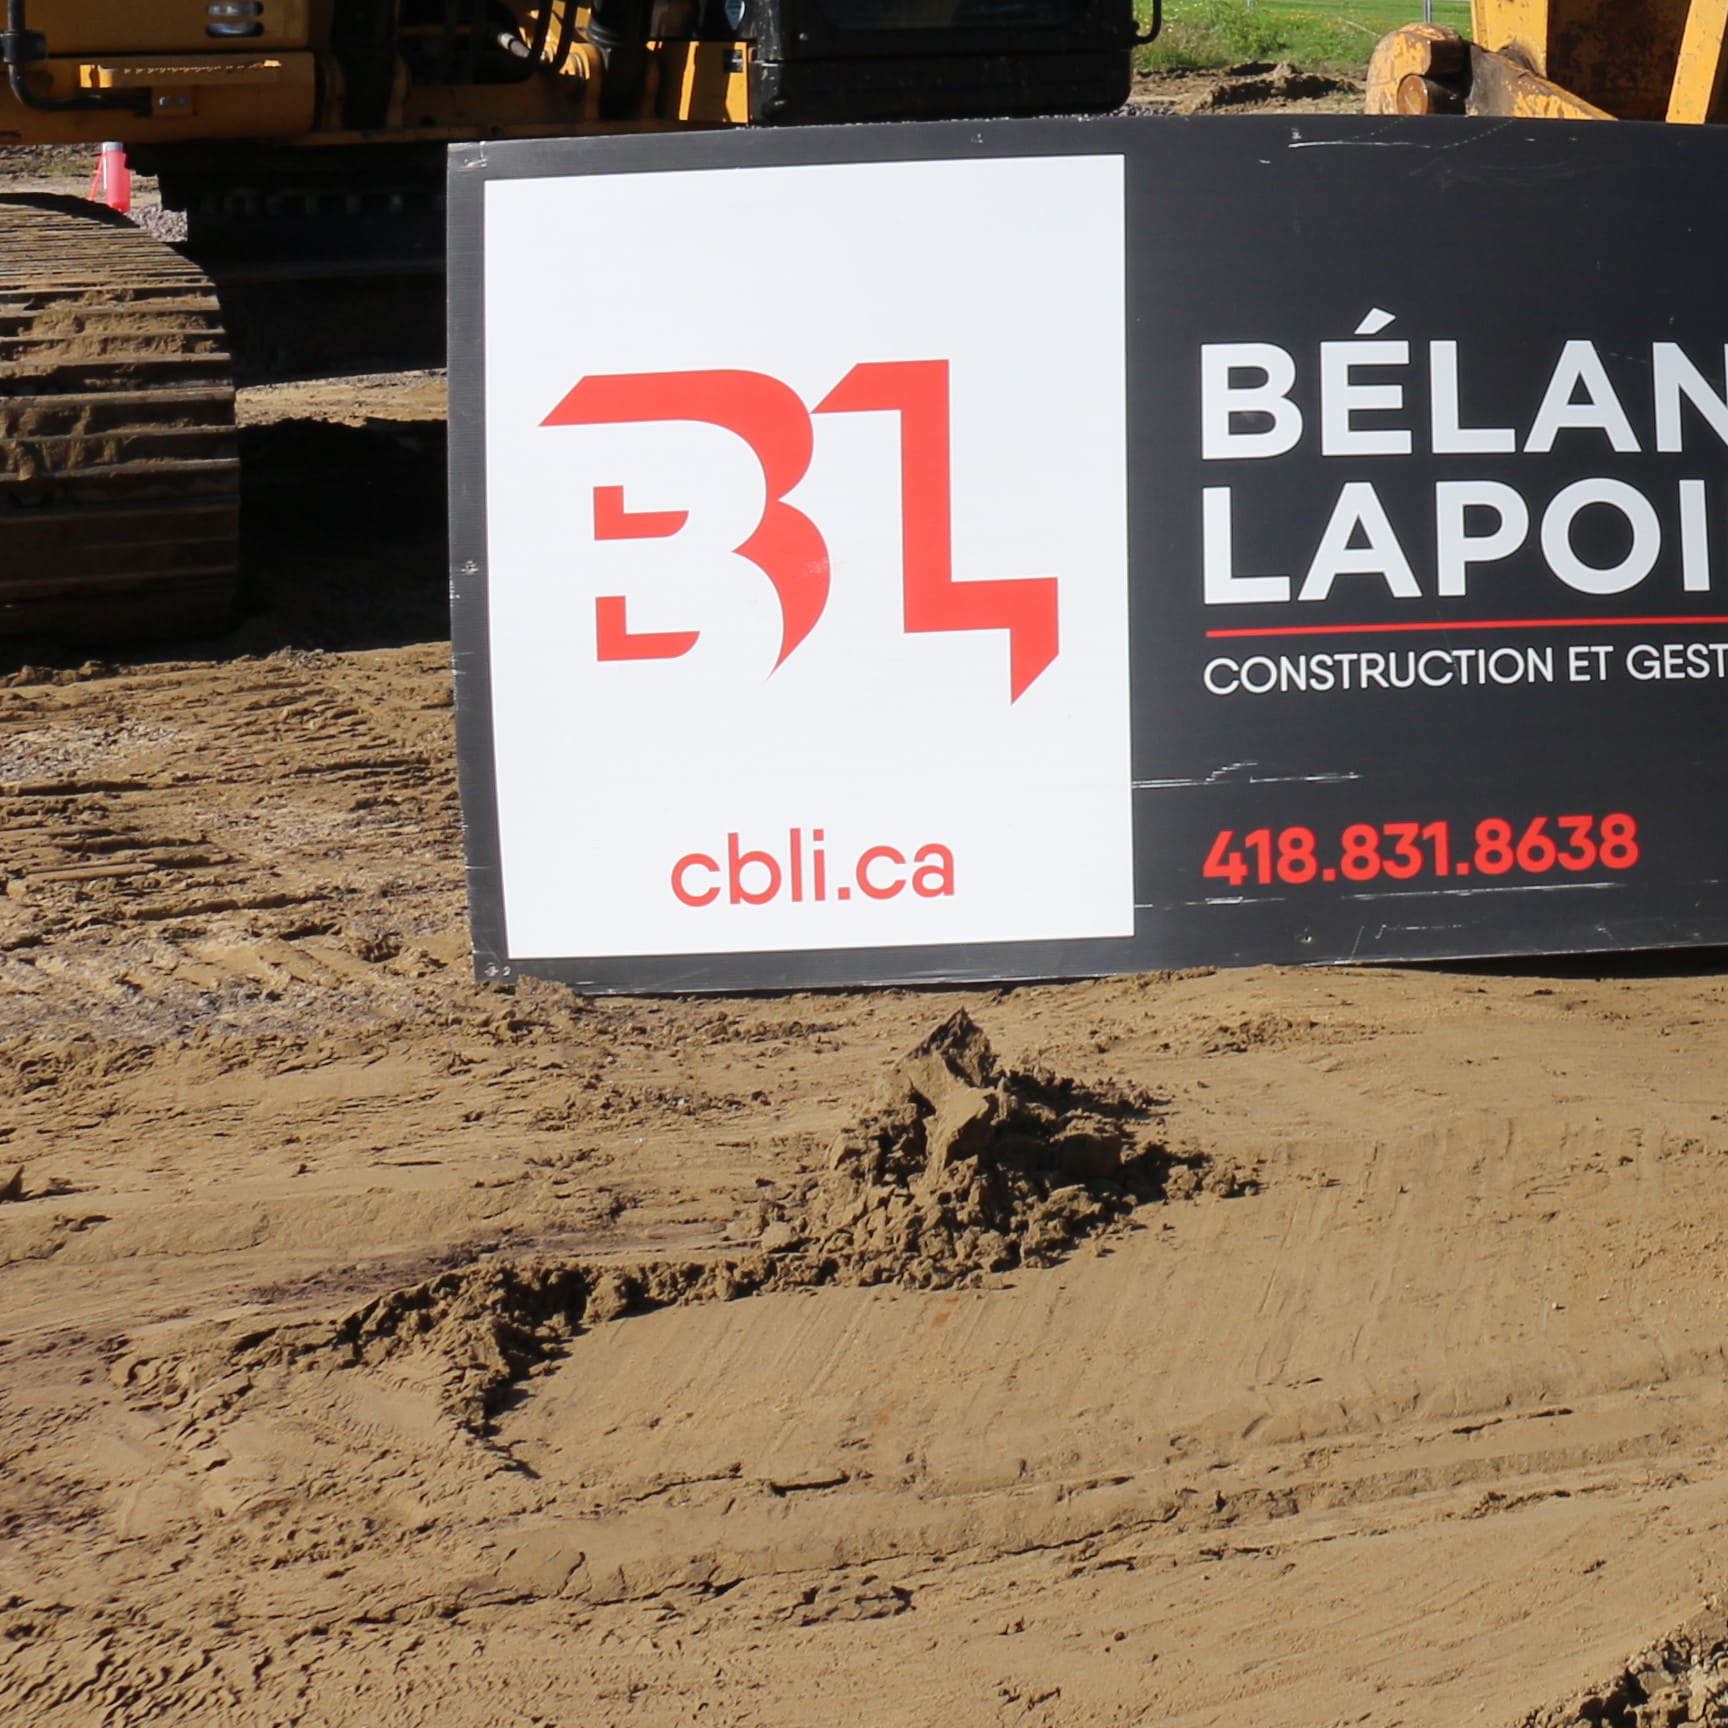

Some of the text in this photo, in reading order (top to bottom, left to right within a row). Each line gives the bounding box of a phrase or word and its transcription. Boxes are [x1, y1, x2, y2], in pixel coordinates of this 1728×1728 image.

[1203, 647, 1554, 695] CONSTRUCTION
[1568, 645, 1614, 682] ET
[671, 828, 955, 907] cbli.ca
[1203, 813, 1640, 886] 418.831.8638
